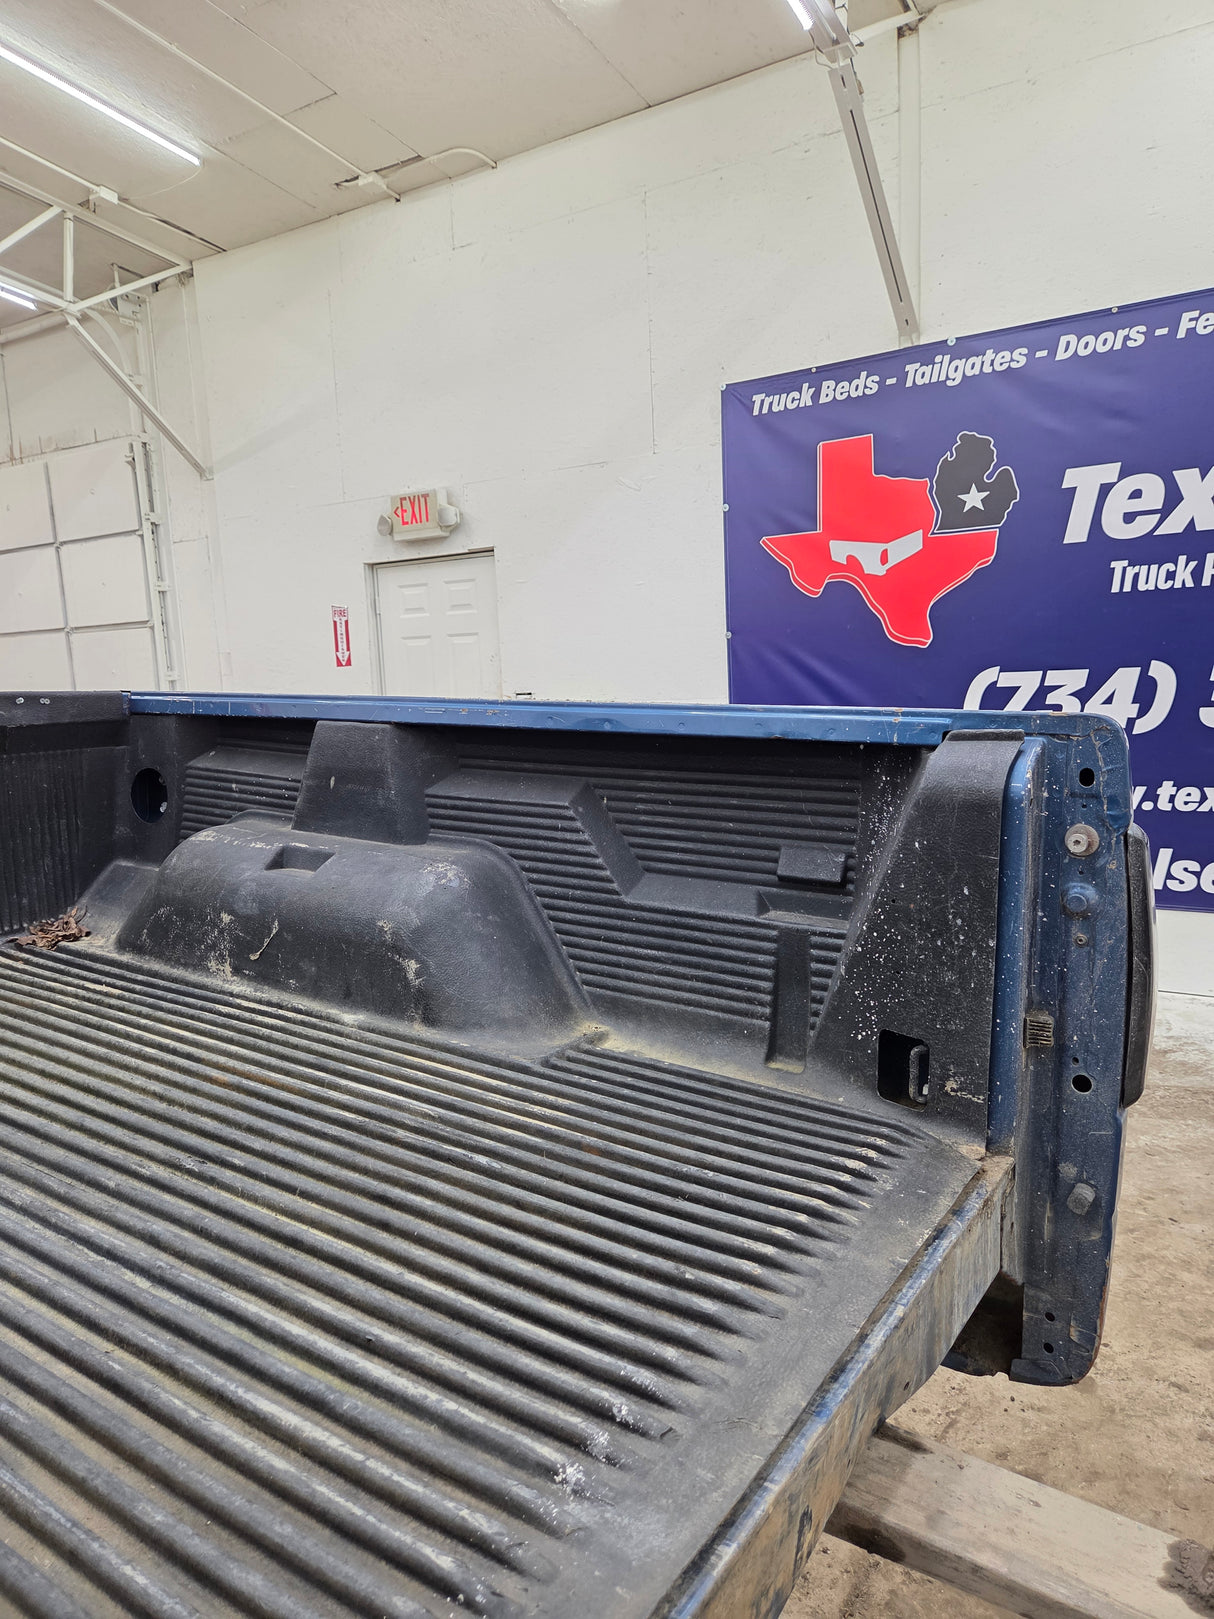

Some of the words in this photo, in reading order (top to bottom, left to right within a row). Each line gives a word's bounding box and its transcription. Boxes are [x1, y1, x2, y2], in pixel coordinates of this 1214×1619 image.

[752, 383, 815, 416] Truck
[819, 371, 879, 404] Beds
[904, 347, 1028, 387] Tailgates
[1055, 325, 1147, 360] Doors
[1176, 310, 1214, 339] Fe
[400, 493, 429, 526] EXIT
[1061, 461, 1214, 545] Tex
[1110, 554, 1198, 593] Truck
[333, 608, 347, 618] FIRE
[963, 659, 1177, 735] (734)
